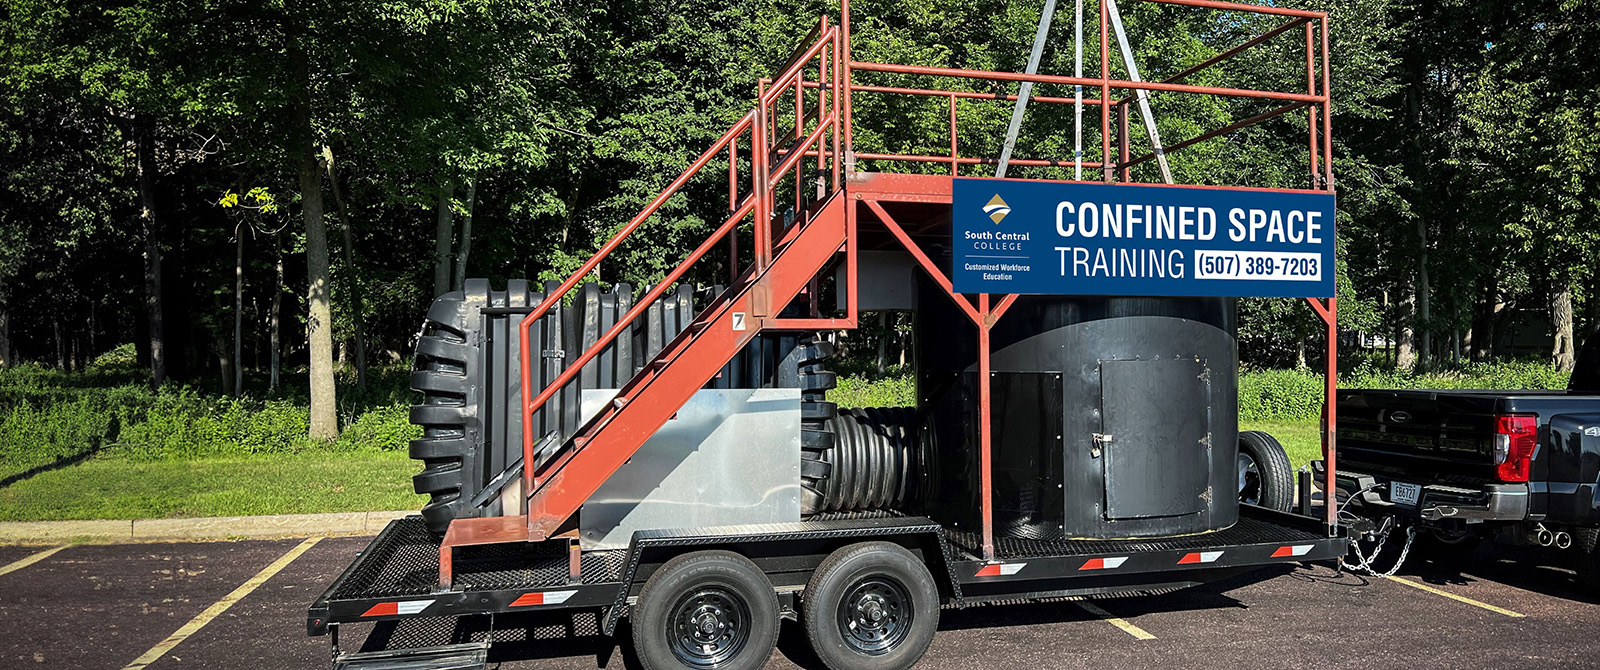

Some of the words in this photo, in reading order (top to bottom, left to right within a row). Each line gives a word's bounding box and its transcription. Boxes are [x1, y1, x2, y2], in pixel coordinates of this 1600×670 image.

[1055, 200, 1217, 241] CONFINED
[1228, 207, 1322, 244] SPACE
[964, 230, 993, 240] South
[995, 231, 1030, 241] Central
[973, 241, 1022, 251] COLLEGE
[964, 262, 999, 271] Customized
[1000, 263, 1031, 272] Workforce
[1054, 246, 1185, 279] TRAINING
[1198, 253, 1241, 277] (507)
[1245, 257, 1318, 276] 389-7203
[983, 272, 1013, 281] Education
[734, 313, 745, 329] 7
